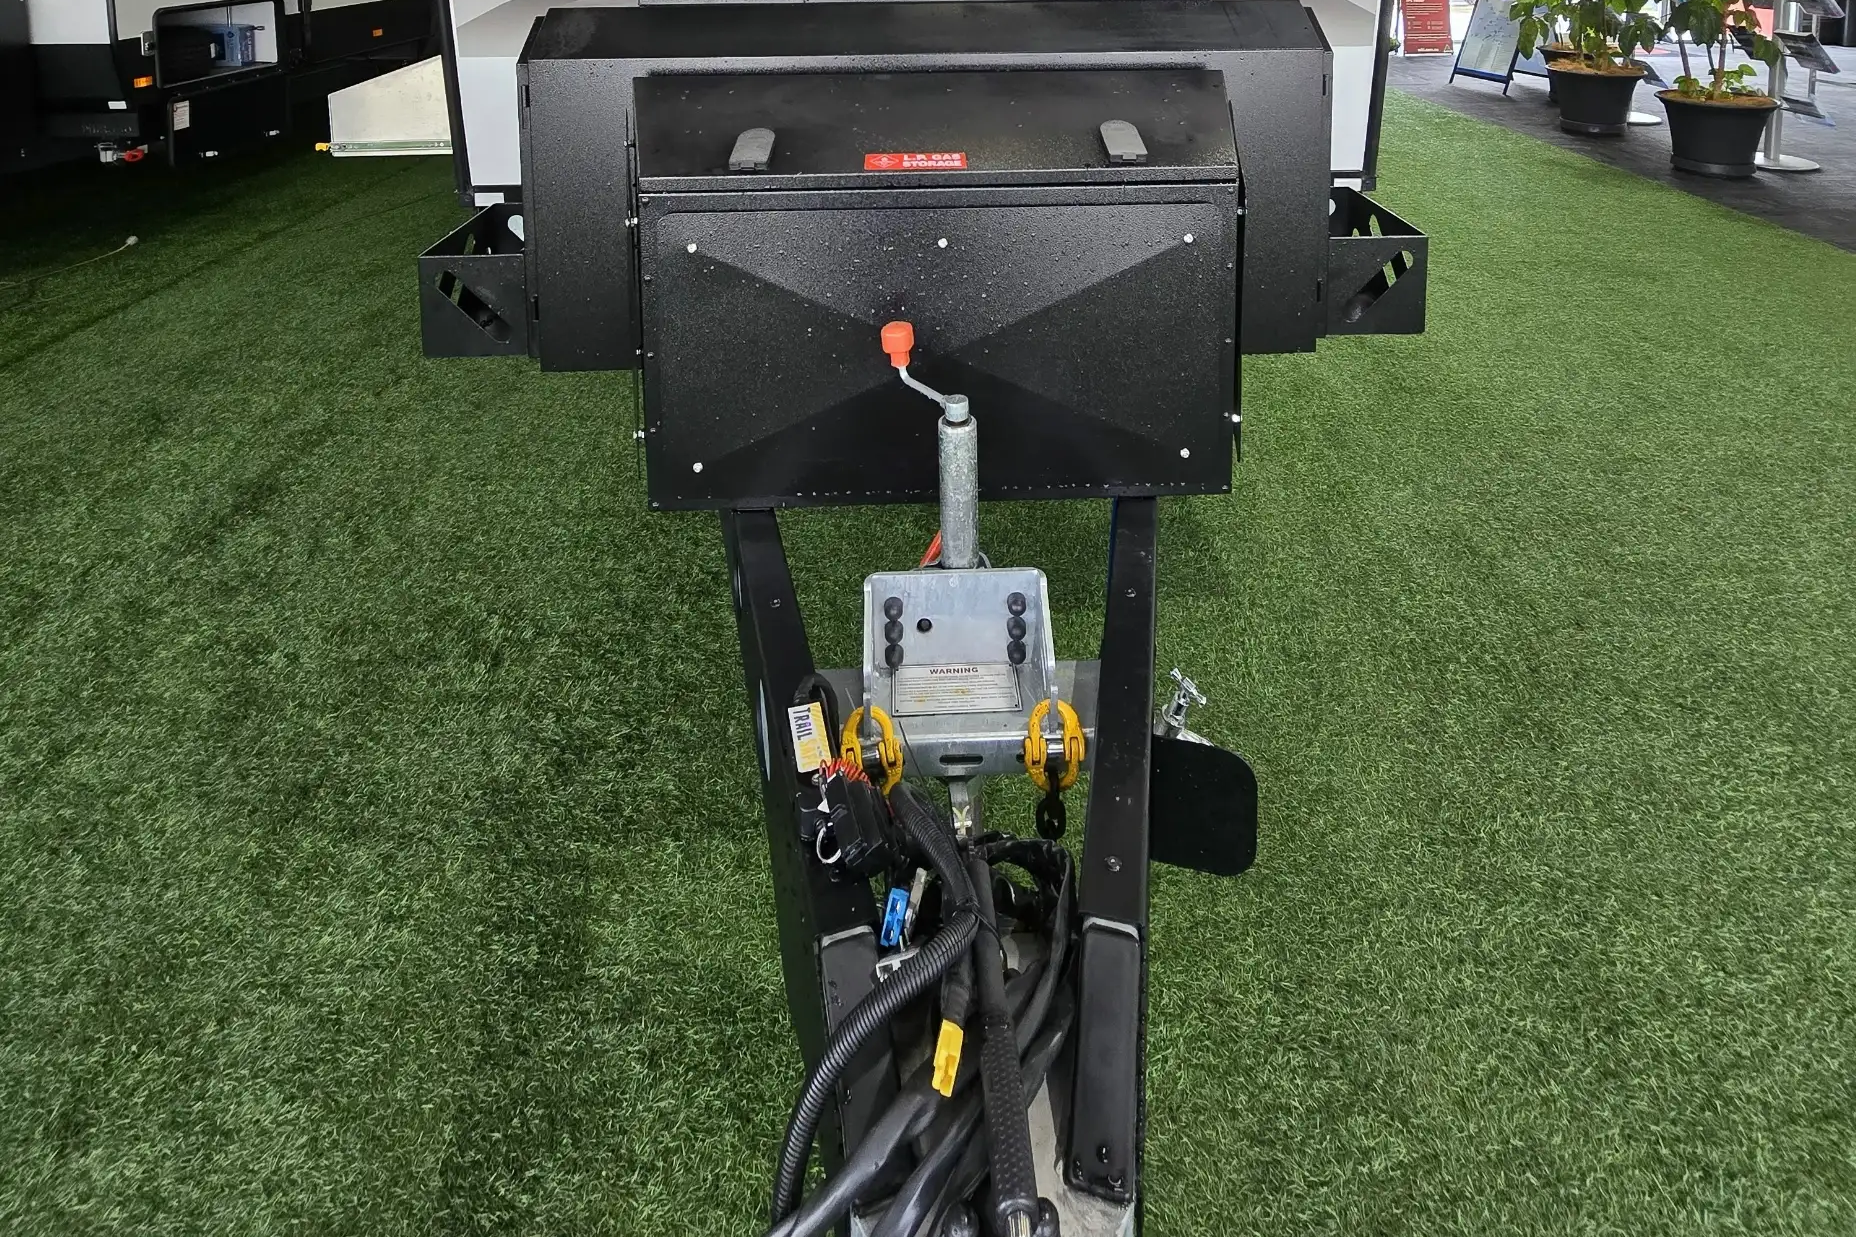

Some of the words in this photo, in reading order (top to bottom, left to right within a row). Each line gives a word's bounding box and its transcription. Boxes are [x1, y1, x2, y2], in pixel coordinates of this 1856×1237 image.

[902, 160, 962, 168] STORAGE
[929, 666, 979, 675] WARNING
[792, 707, 813, 741] TRAIL
